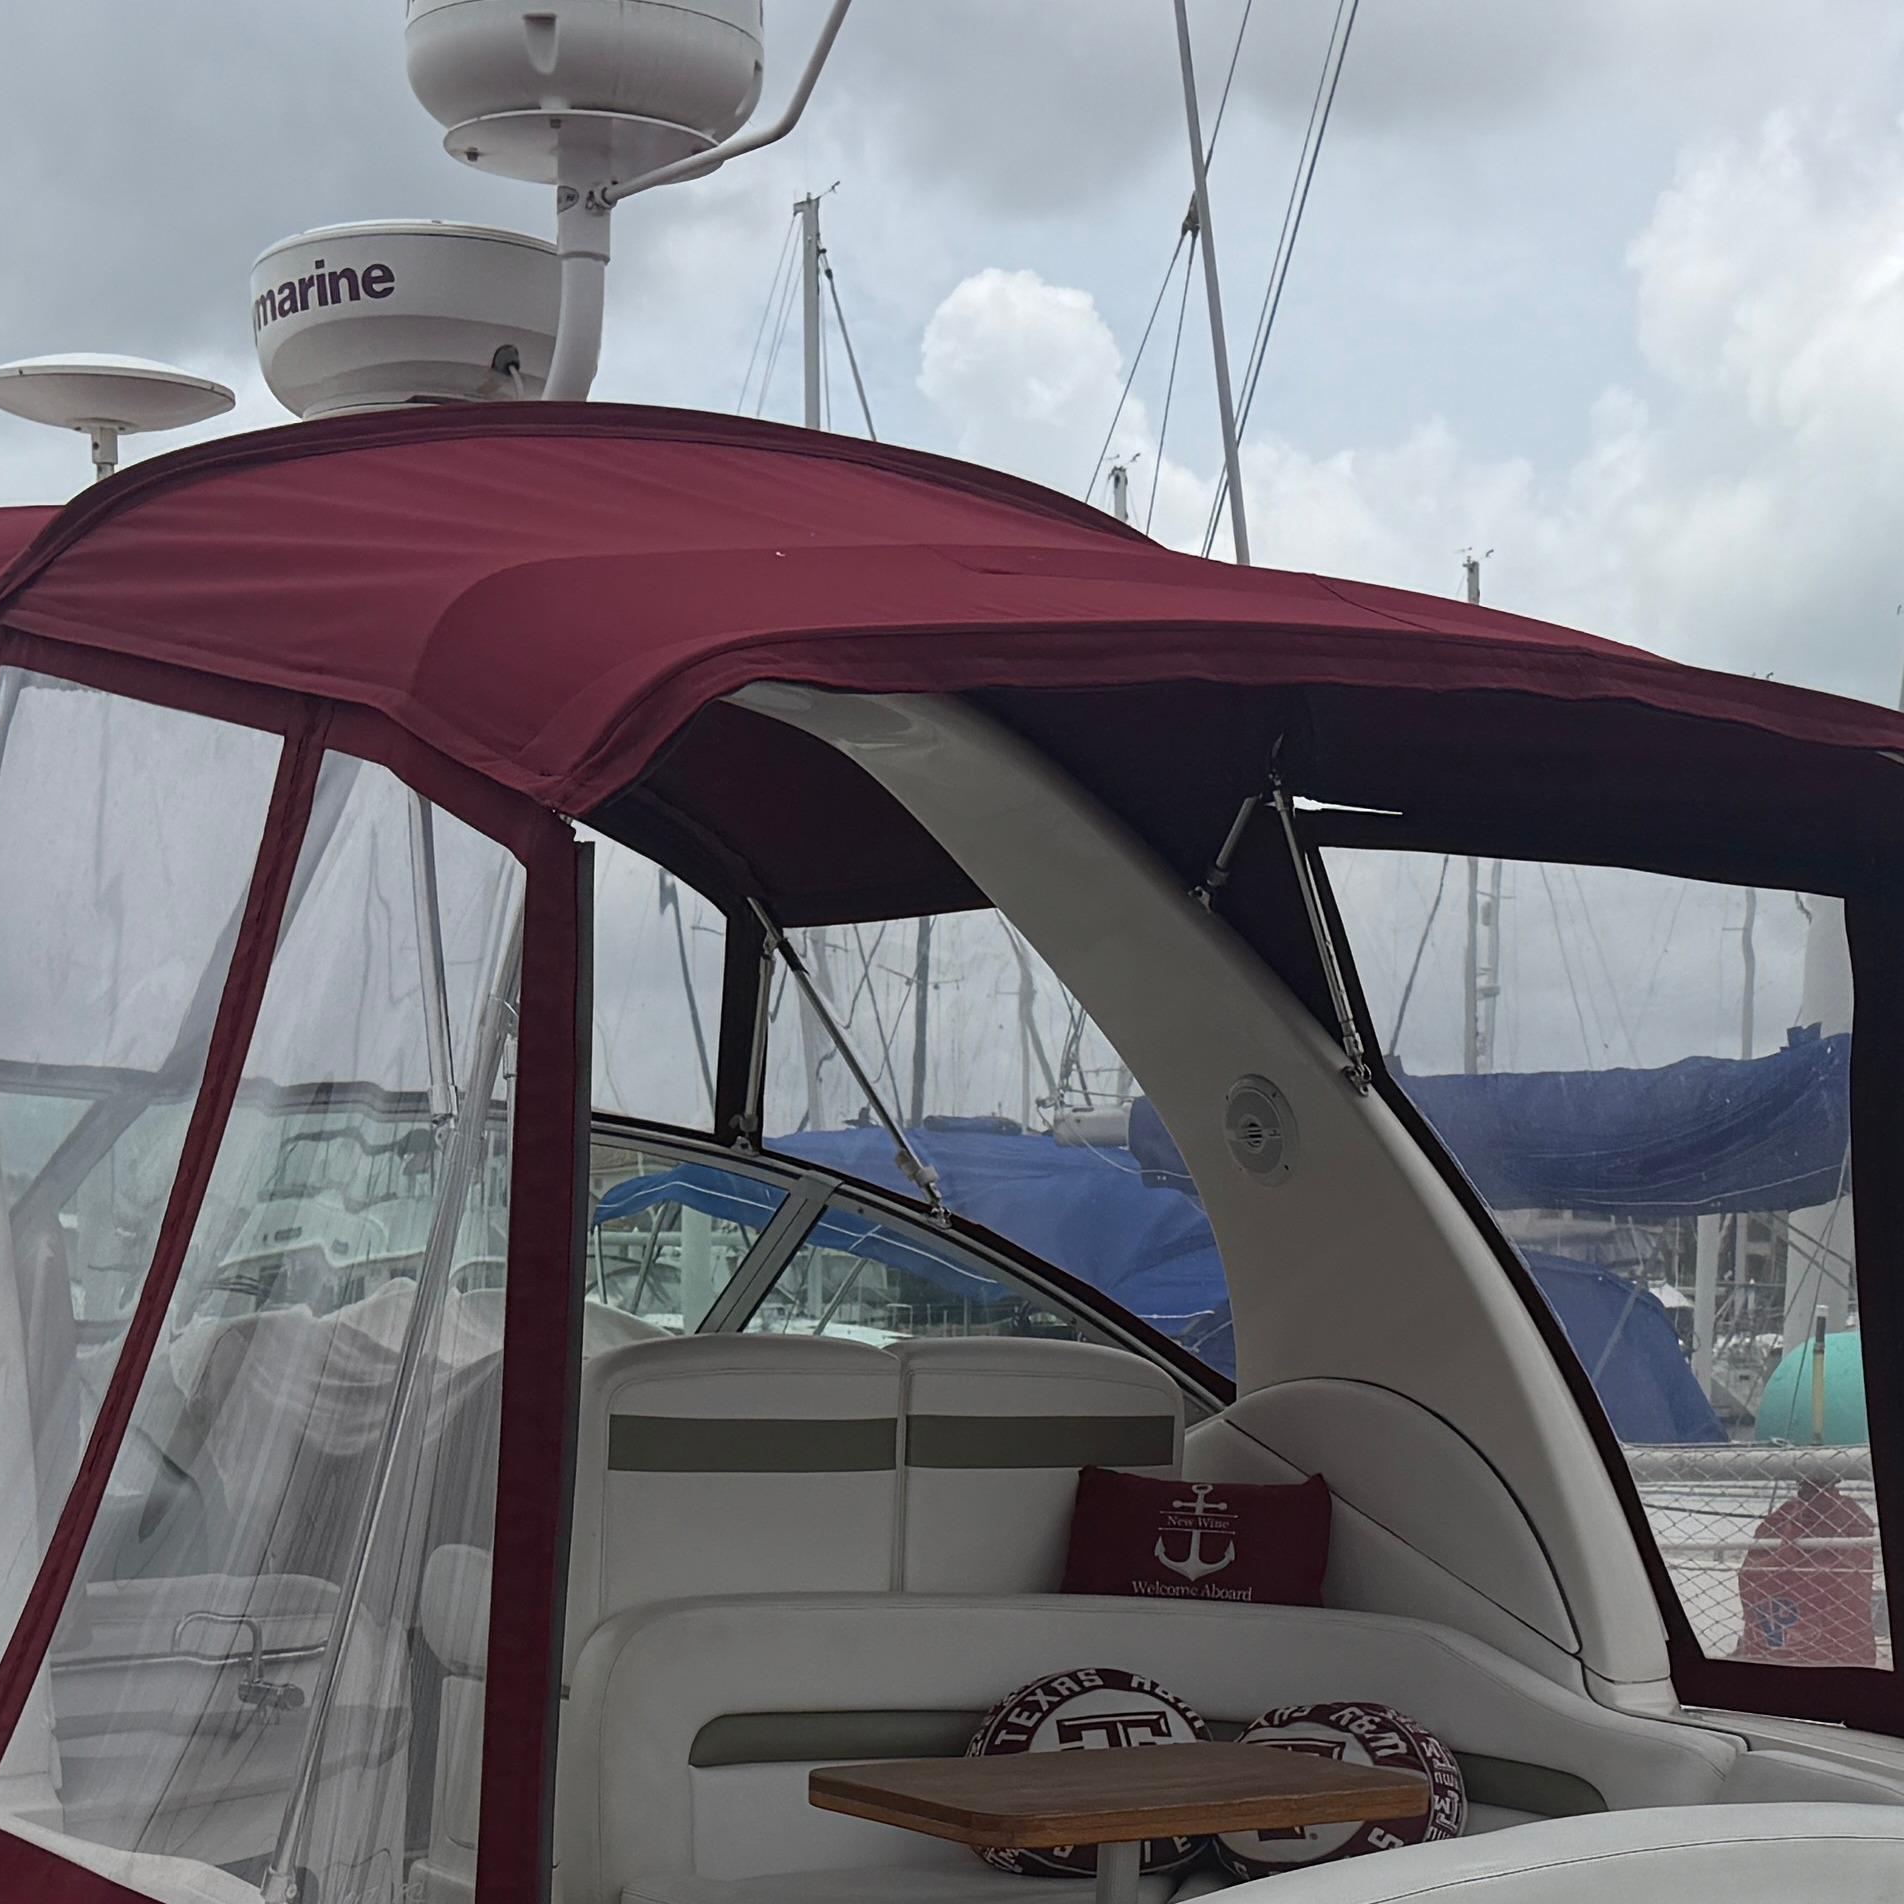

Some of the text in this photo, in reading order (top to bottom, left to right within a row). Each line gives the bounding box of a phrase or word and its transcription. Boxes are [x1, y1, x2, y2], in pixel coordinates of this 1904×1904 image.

[1167, 1515, 1230, 1529] New Wine
[1132, 1581, 1253, 1602] Welcome Aboard
[995, 1668, 1104, 1746] TEXAS
